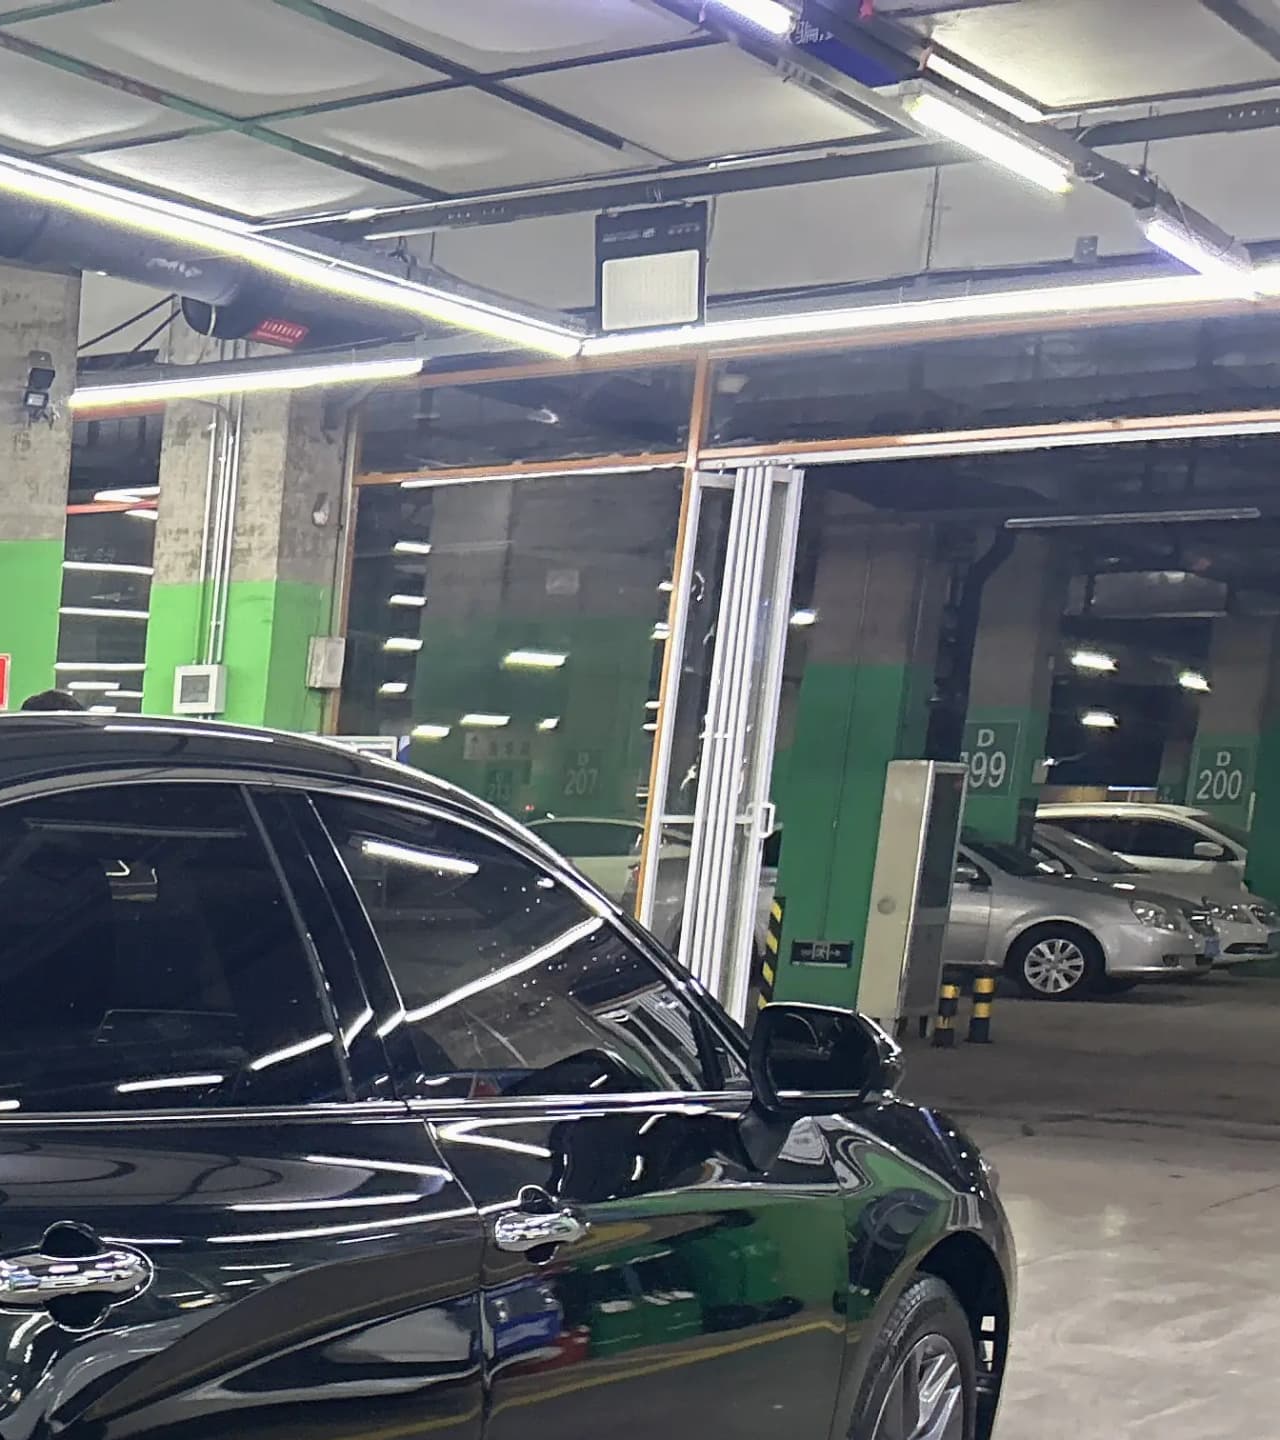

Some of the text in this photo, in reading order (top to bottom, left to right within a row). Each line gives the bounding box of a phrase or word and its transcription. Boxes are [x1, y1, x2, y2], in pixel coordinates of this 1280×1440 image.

[976, 728, 995, 748] D
[1215, 750, 1231, 767] D
[1196, 769, 1242, 800] 200
